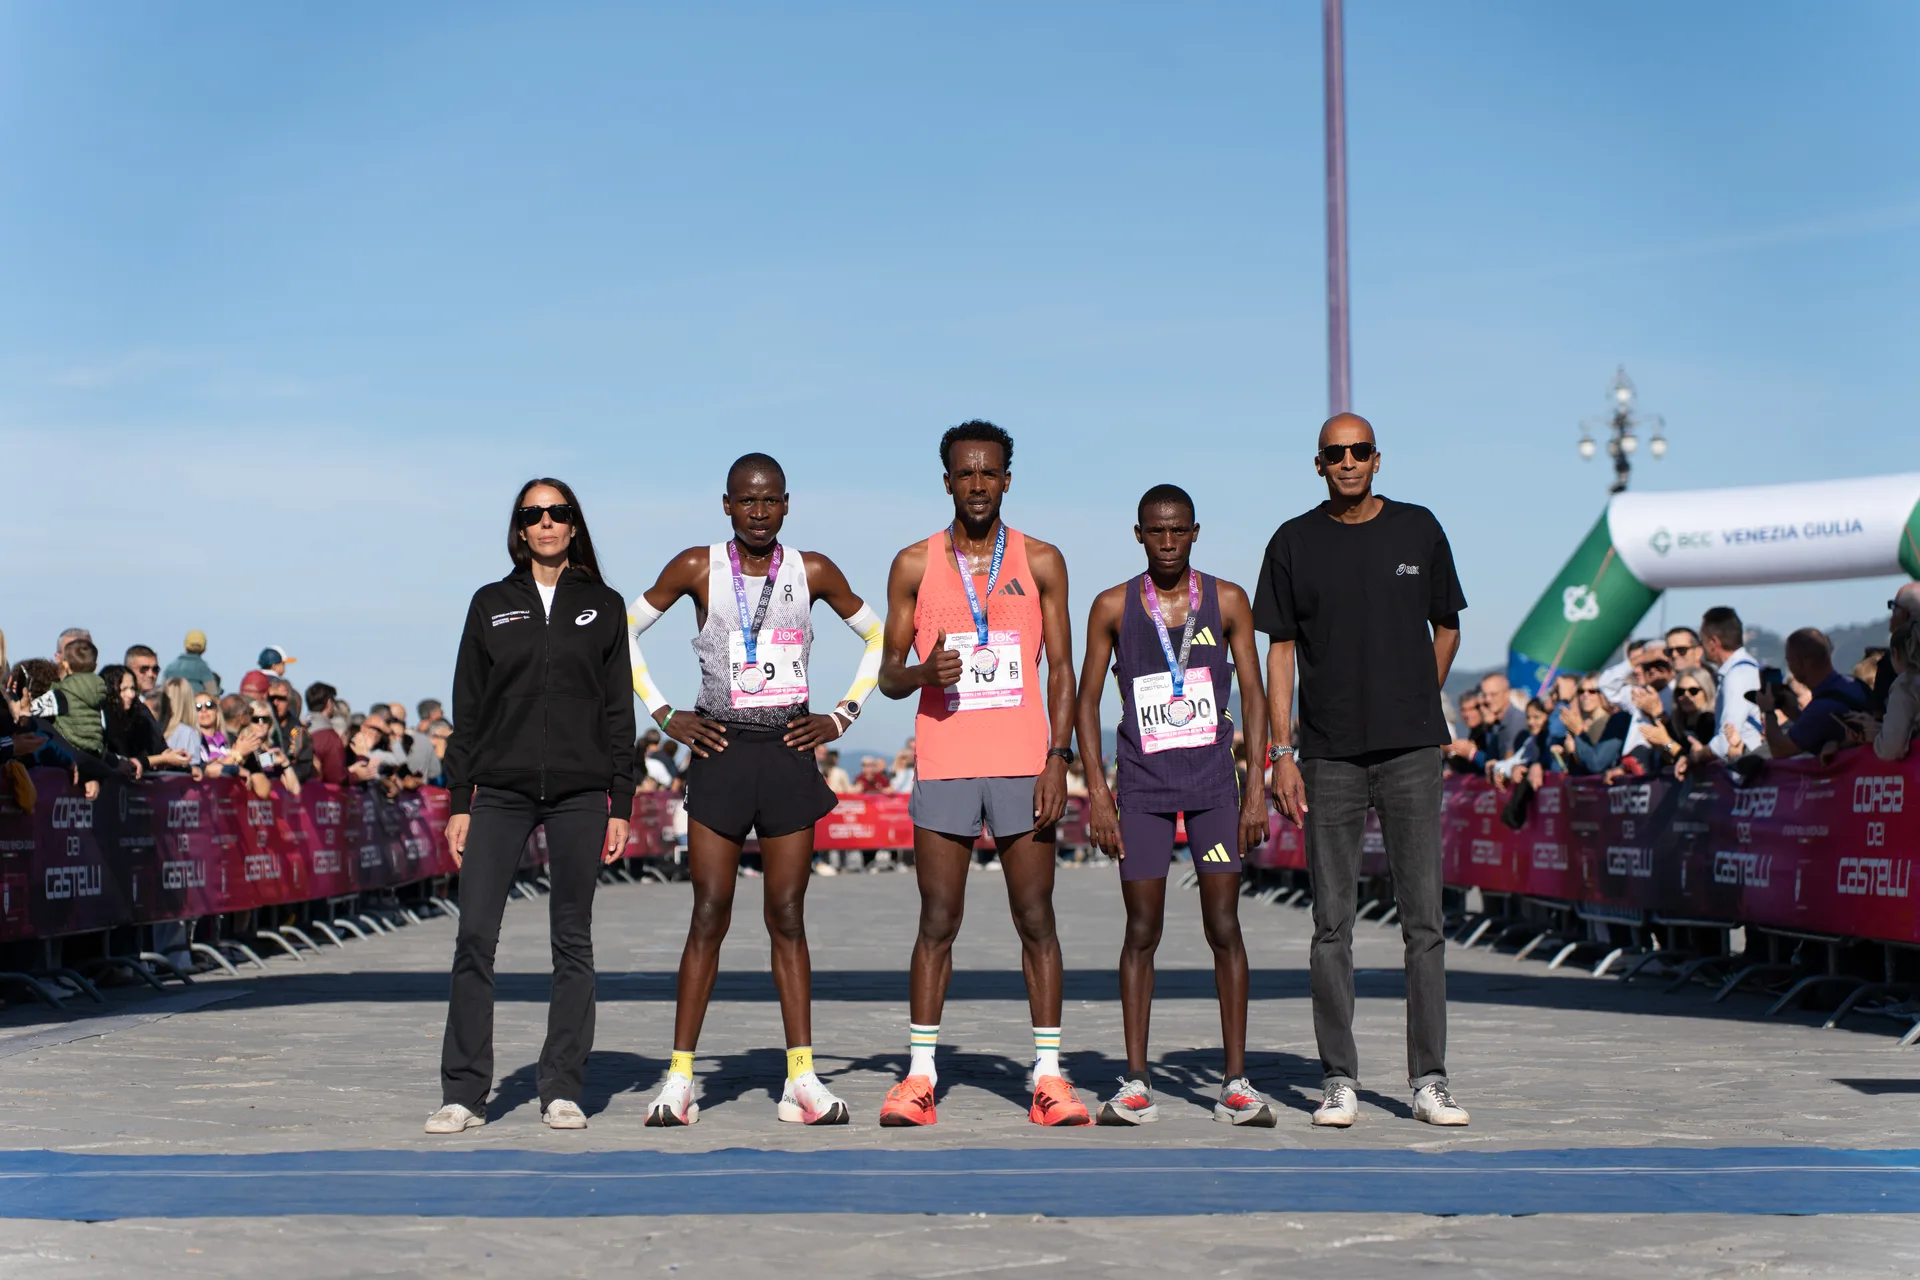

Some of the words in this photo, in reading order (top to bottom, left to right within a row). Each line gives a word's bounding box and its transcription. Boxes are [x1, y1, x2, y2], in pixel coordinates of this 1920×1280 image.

[1678, 531, 1712, 548] BCC
[1721, 525, 1799, 546] VENEZIA
[1803, 518, 1864, 540] GIULIA
[776, 631, 797, 641] 10K
[763, 662, 776, 681] 9
